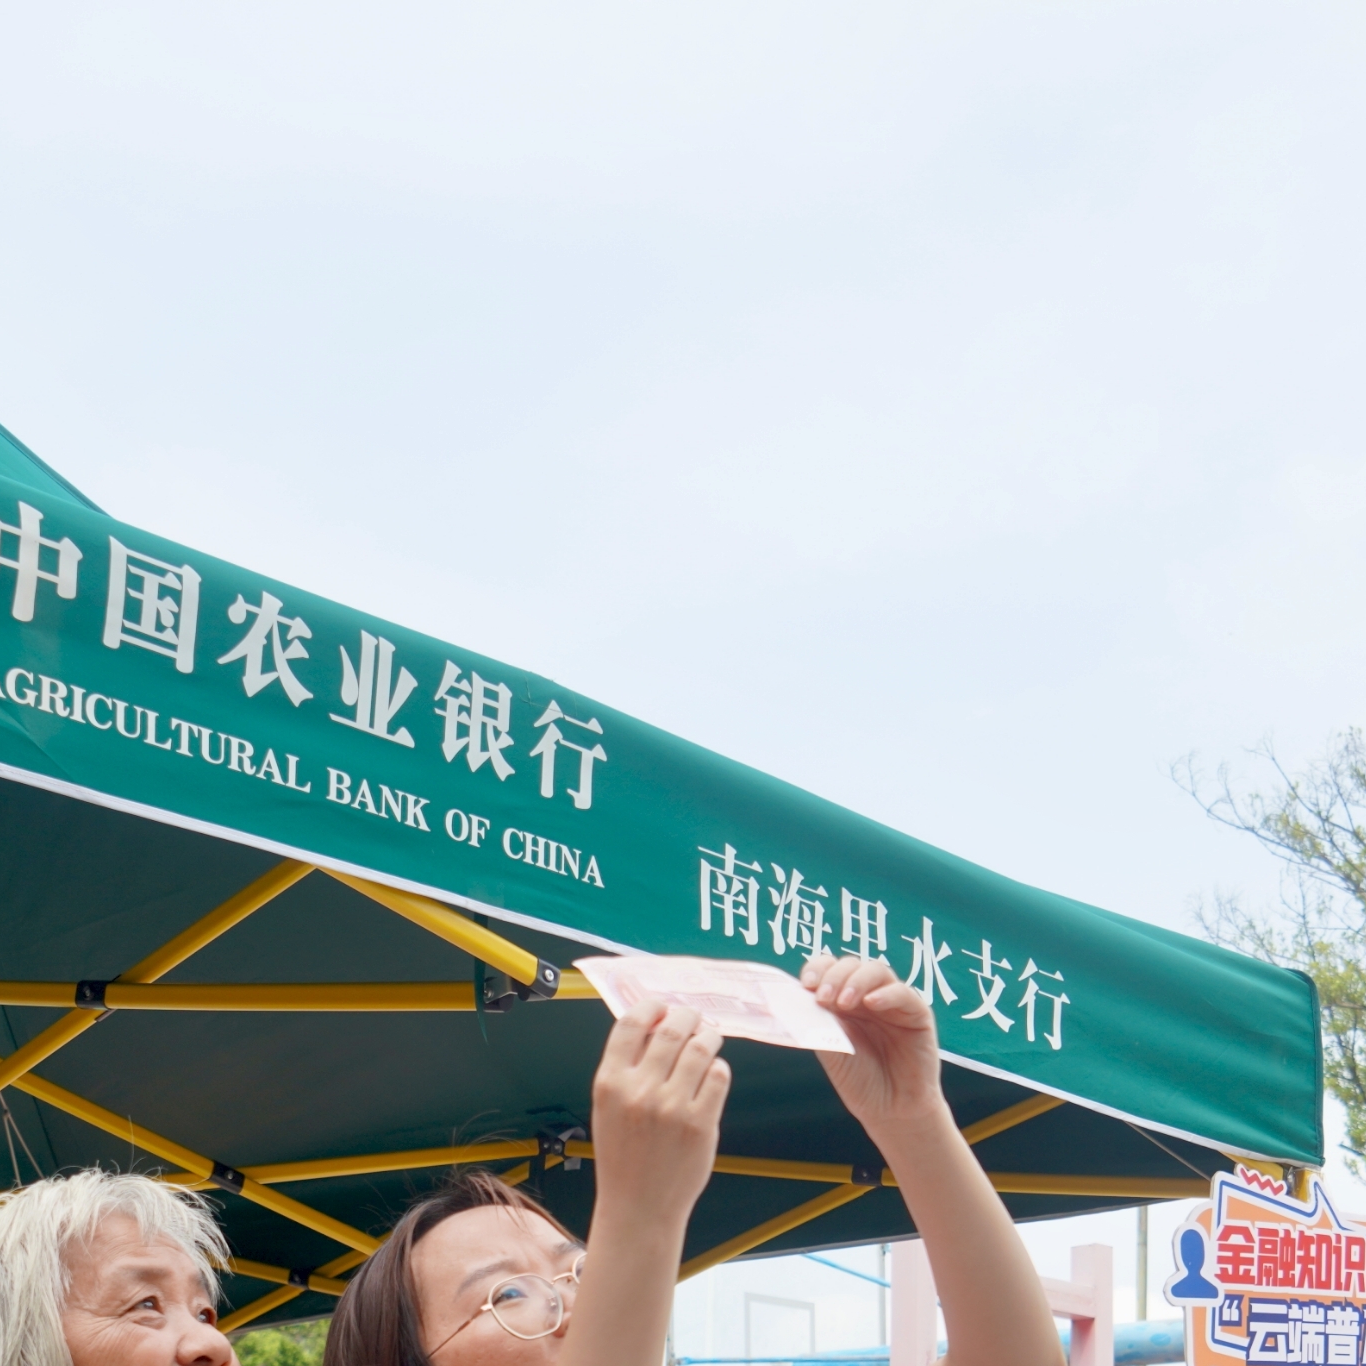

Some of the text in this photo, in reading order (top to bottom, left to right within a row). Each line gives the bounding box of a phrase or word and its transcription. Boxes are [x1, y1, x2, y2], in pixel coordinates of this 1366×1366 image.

[326, 766, 431, 832] BANK
[445, 808, 490, 848] OF
[502, 829, 605, 888] CHINA
[697, 842, 1071, 1050] 南海里水支行
[1214, 1223, 1366, 1293] 金融知识
